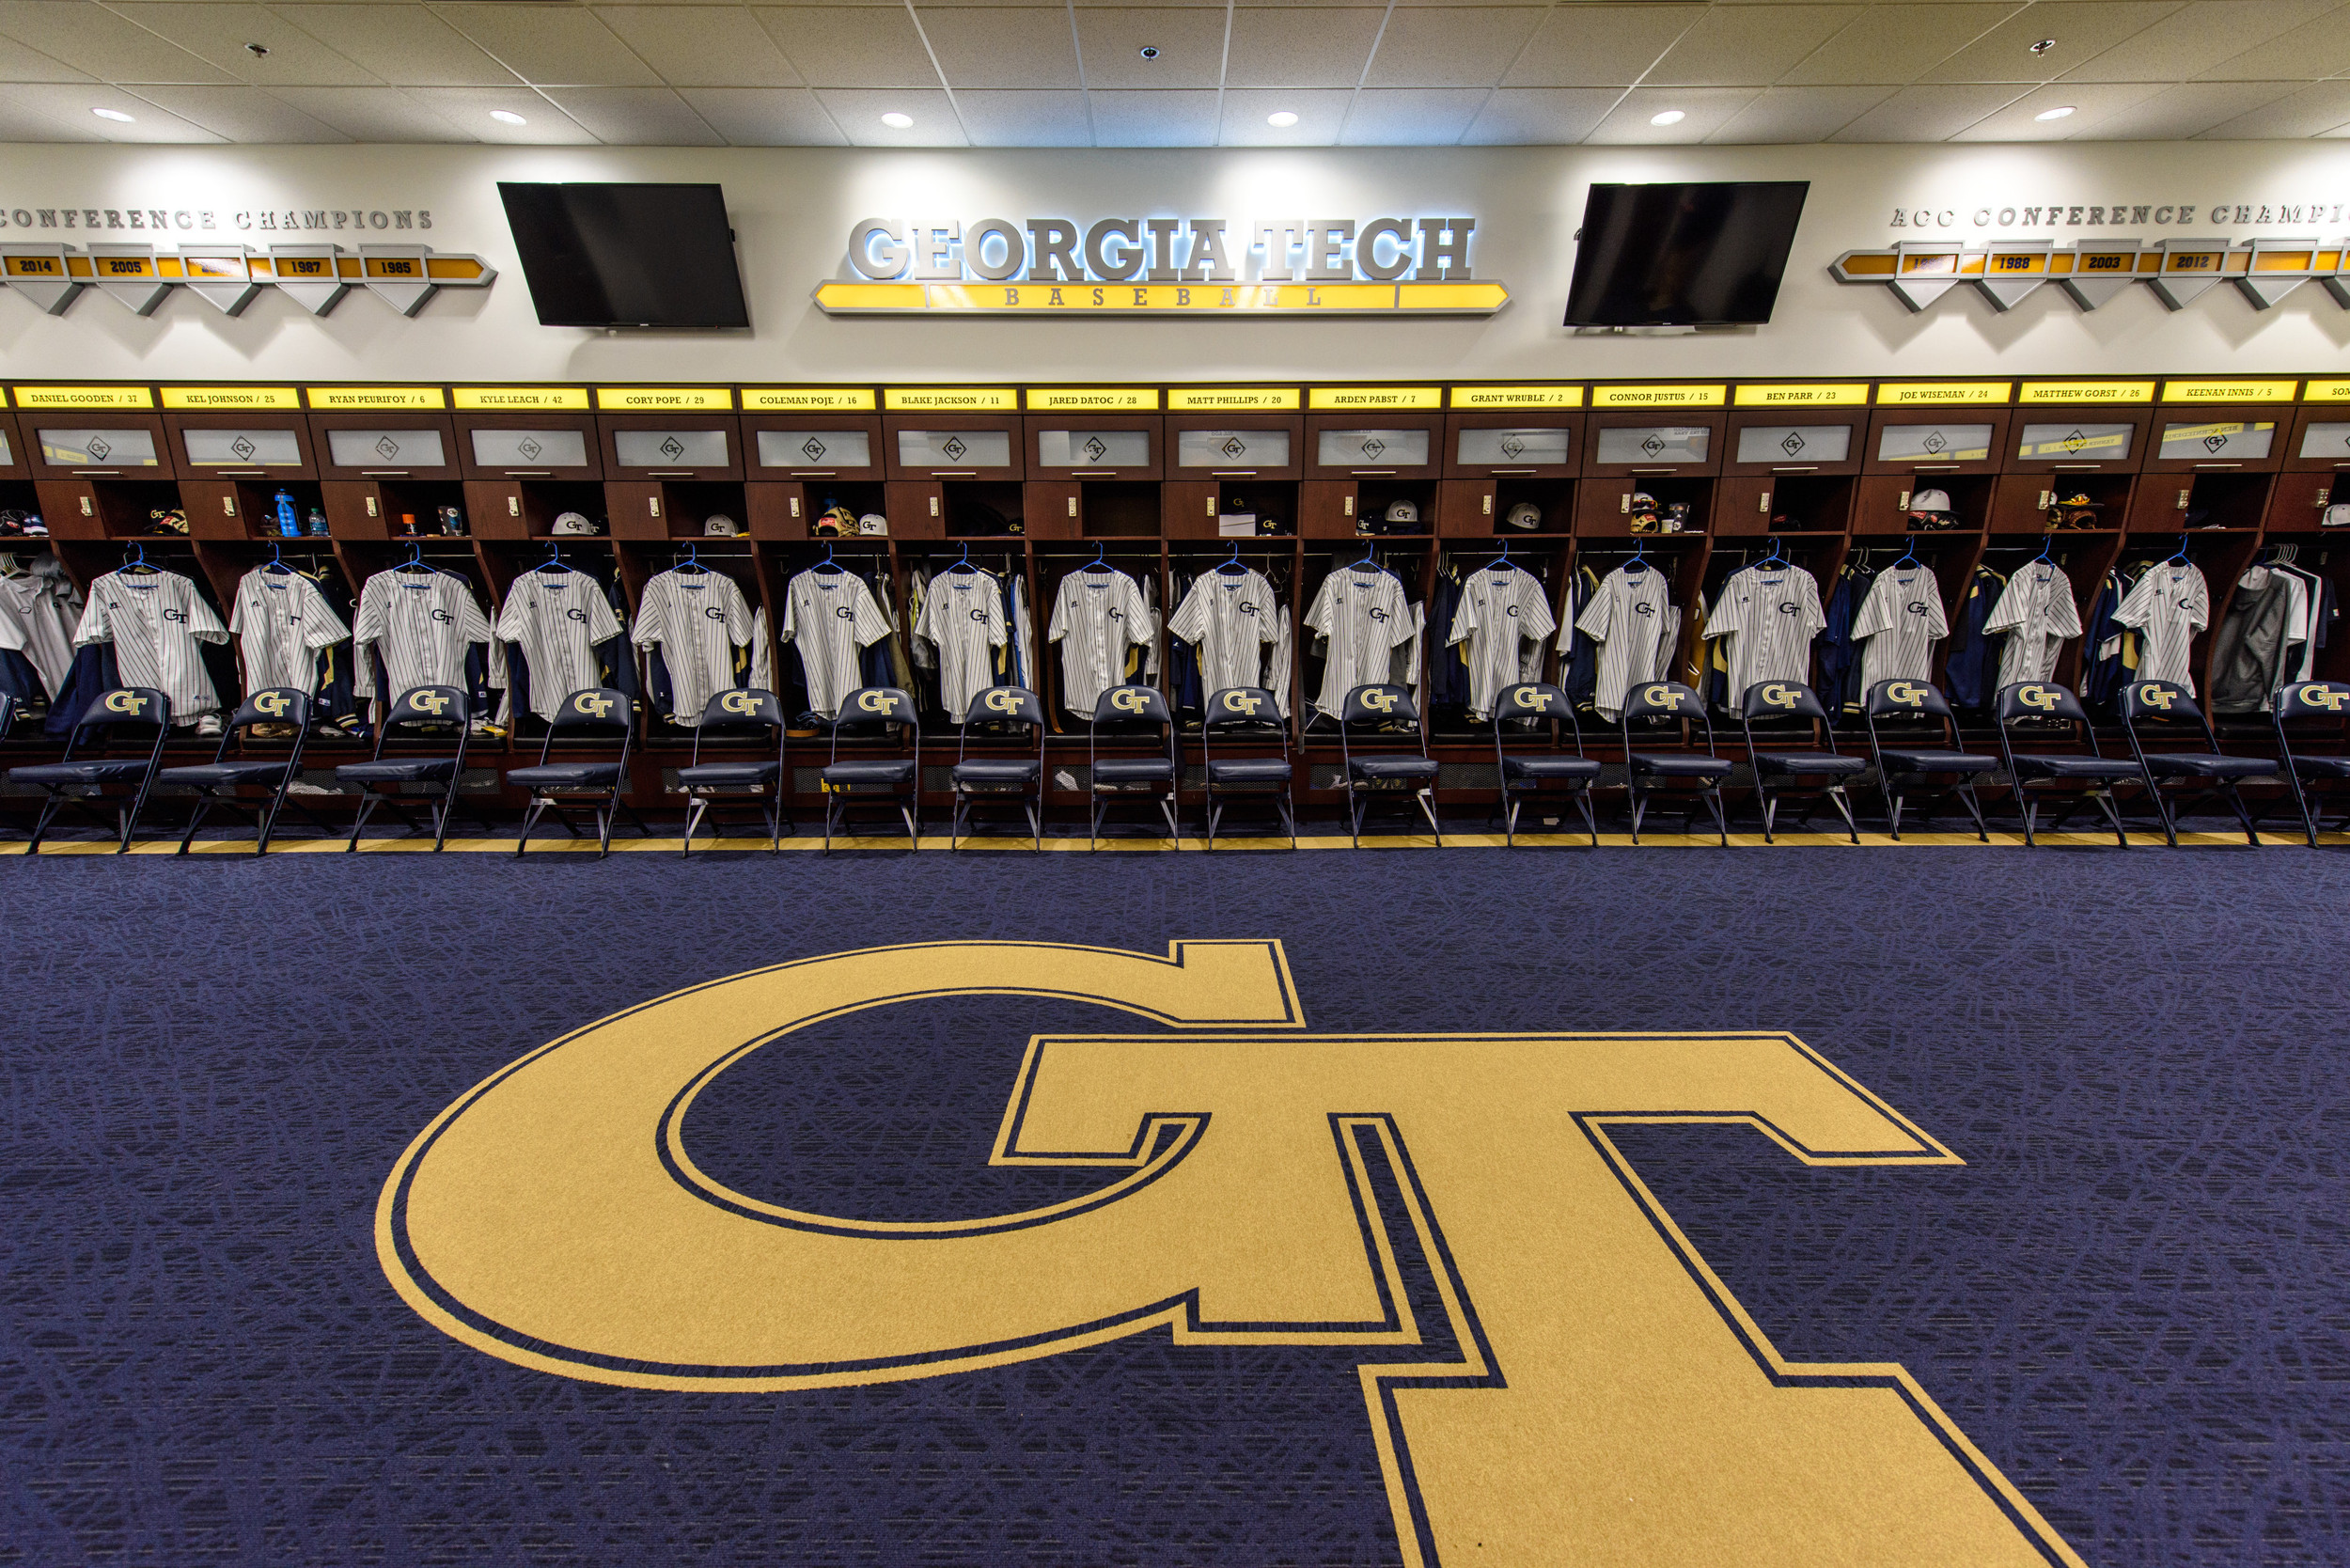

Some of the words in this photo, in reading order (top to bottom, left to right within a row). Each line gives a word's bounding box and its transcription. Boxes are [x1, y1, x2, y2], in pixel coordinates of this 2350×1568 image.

[232, 209, 433, 230] CHAMPIONS
[1890, 207, 1955, 227] ACC
[1974, 205, 2196, 227] CONFERENCE
[2211, 203, 2350, 225] CHAMPI
[847, 218, 1235, 280] GEORGIA
[1251, 218, 1477, 280] TECH
[21, 260, 53, 273] 2014
[110, 261, 142, 274] 2005
[291, 261, 321, 274] 1987
[381, 261, 412, 274] 1985
[1999, 257, 2031, 269] 1988
[2088, 256, 2121, 269] 2003
[2176, 256, 2210, 268] 2012
[1005, 288, 1322, 308] BASEBALL
[30, 394, 70, 403] DANIEL
[70, 394, 115, 403] GOODEN
[127, 394, 138, 403] 37
[186, 395, 208, 403] KEL
[207, 395, 254, 405] JOHNSON
[264, 395, 275, 403] 25
[328, 395, 356, 404] RYAN
[357, 395, 406, 404] PEURIFOY
[419, 395, 426, 404] 6
[479, 395, 506, 404] KYLE
[507, 395, 540, 404] LEACH
[552, 396, 563, 404] 42
[1334, 395, 1368, 404] ARDEN
[1369, 395, 1399, 403] PABST
[1410, 395, 1417, 403] 7
[1470, 394, 1505, 403] GRANT
[1505, 394, 1545, 402] WRUBLE
[1557, 394, 1563, 402] 2
[1608, 393, 1653, 401] CONNOR
[1653, 392, 1686, 403] JUSTUS
[1698, 392, 1710, 401] 15
[1765, 392, 1786, 400] BEN
[1787, 392, 1813, 400] PARR
[1825, 391, 1837, 400] 23
[1899, 391, 1919, 401] JOE
[1919, 390, 1966, 399] WISEMAN
[1977, 389, 1988, 399] 24
[2032, 389, 2084, 399] MATTHEW
[2084, 389, 2118, 398] GORST
[2129, 389, 2140, 398] 26
[2186, 388, 2227, 397] KEENAN
[2227, 388, 2254, 397] INNIS
[2266, 388, 2272, 397] 5
[625, 396, 653, 405] CORY
[655, 396, 682, 404] POPE
[694, 396, 705, 404] 29
[760, 396, 808, 405] COLEMAN
[810, 396, 835, 407] POJE
[847, 396, 857, 405] 16
[901, 396, 932, 404] BLAKE
[933, 396, 978, 407] JACKSON
[990, 396, 999, 405] 11
[1048, 396, 1079, 407] JARED
[1080, 396, 1114, 405] DATOC
[1126, 396, 1137, 405] 28
[1186, 396, 1215, 405] MATT
[1216, 396, 1260, 404] PHILLIPS
[1271, 396, 1282, 404] 20
[1397, 510, 1410, 519] GT
[1523, 514, 1537, 525] GT
[566, 521, 582, 531] GT
[711, 523, 726, 532] GT
[863, 521, 877, 531] GT
[1010, 524, 1023, 532] GT
[1263, 520, 1277, 529] GT
[164, 608, 188, 624] GT
[431, 608, 454, 625] GT
[567, 608, 588, 624] GT
[705, 606, 725, 623] GT
[836, 606, 854, 622] GT
[970, 609, 988, 625] GT
[1109, 607, 1123, 623] GT
[1239, 602, 1260, 617] GT
[1370, 607, 1390, 623] GT
[1636, 602, 1654, 618] GT
[1779, 602, 1800, 617] GT
[1908, 602, 1928, 617] GT
[1111, 688, 1150, 713] GT
[1360, 688, 1398, 713] GT
[1513, 687, 1552, 712] GT
[1644, 686, 1684, 710] GT
[1762, 684, 1801, 708] GT
[1888, 682, 1928, 706] GT
[2018, 685, 2061, 711] GT
[2139, 684, 2177, 710] GT
[2298, 684, 2349, 711] GT
[105, 691, 148, 715] GT
[254, 692, 291, 717] GT
[409, 690, 449, 714] GT
[574, 692, 614, 717] GT
[721, 691, 763, 716] GT
[857, 690, 899, 715] GT
[985, 690, 1024, 714] GT
[1223, 690, 1261, 714] GT
[373, 937, 2089, 1568] GT
